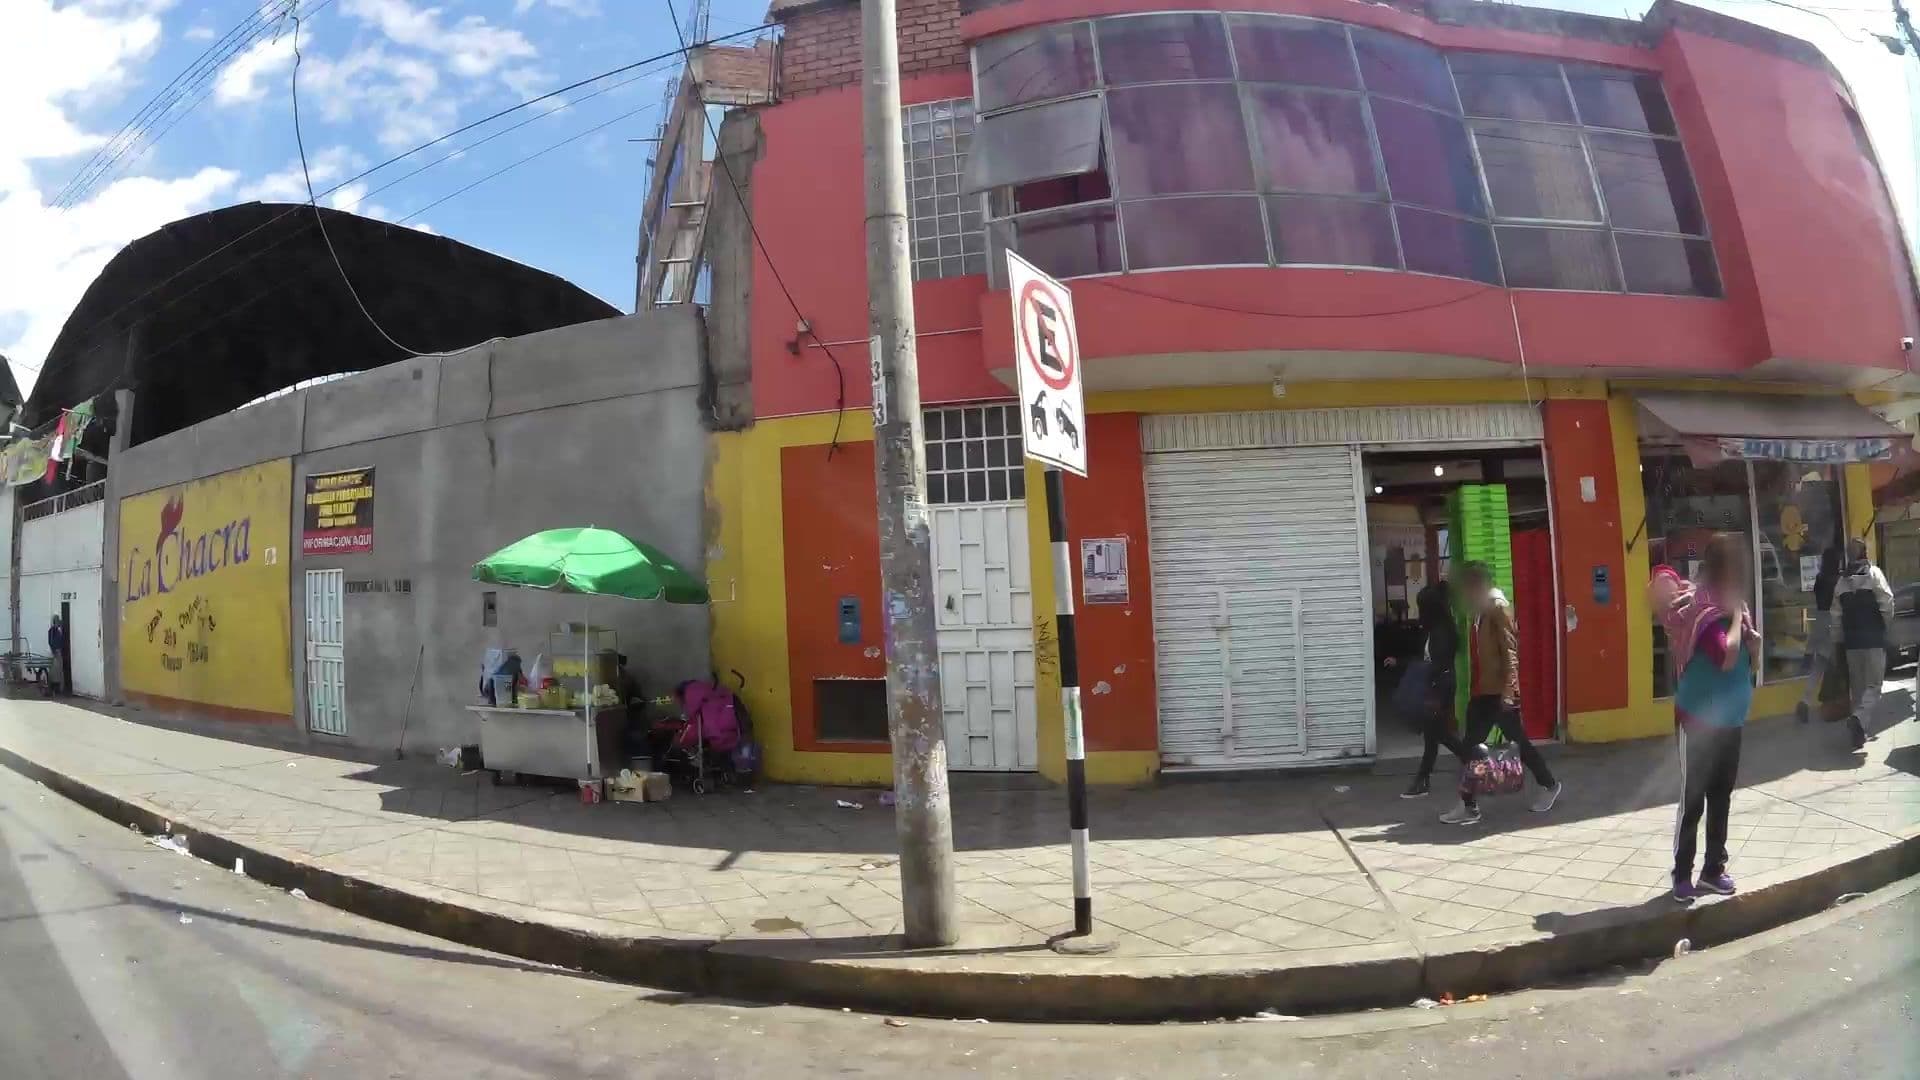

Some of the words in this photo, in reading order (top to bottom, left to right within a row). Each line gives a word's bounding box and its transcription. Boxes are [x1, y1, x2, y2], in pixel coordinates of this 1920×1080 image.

[1035, 298, 1063, 373] E
[126, 547, 151, 602] La
[156, 514, 250, 594] Chacra
[353, 533, 372, 546] AQUI
